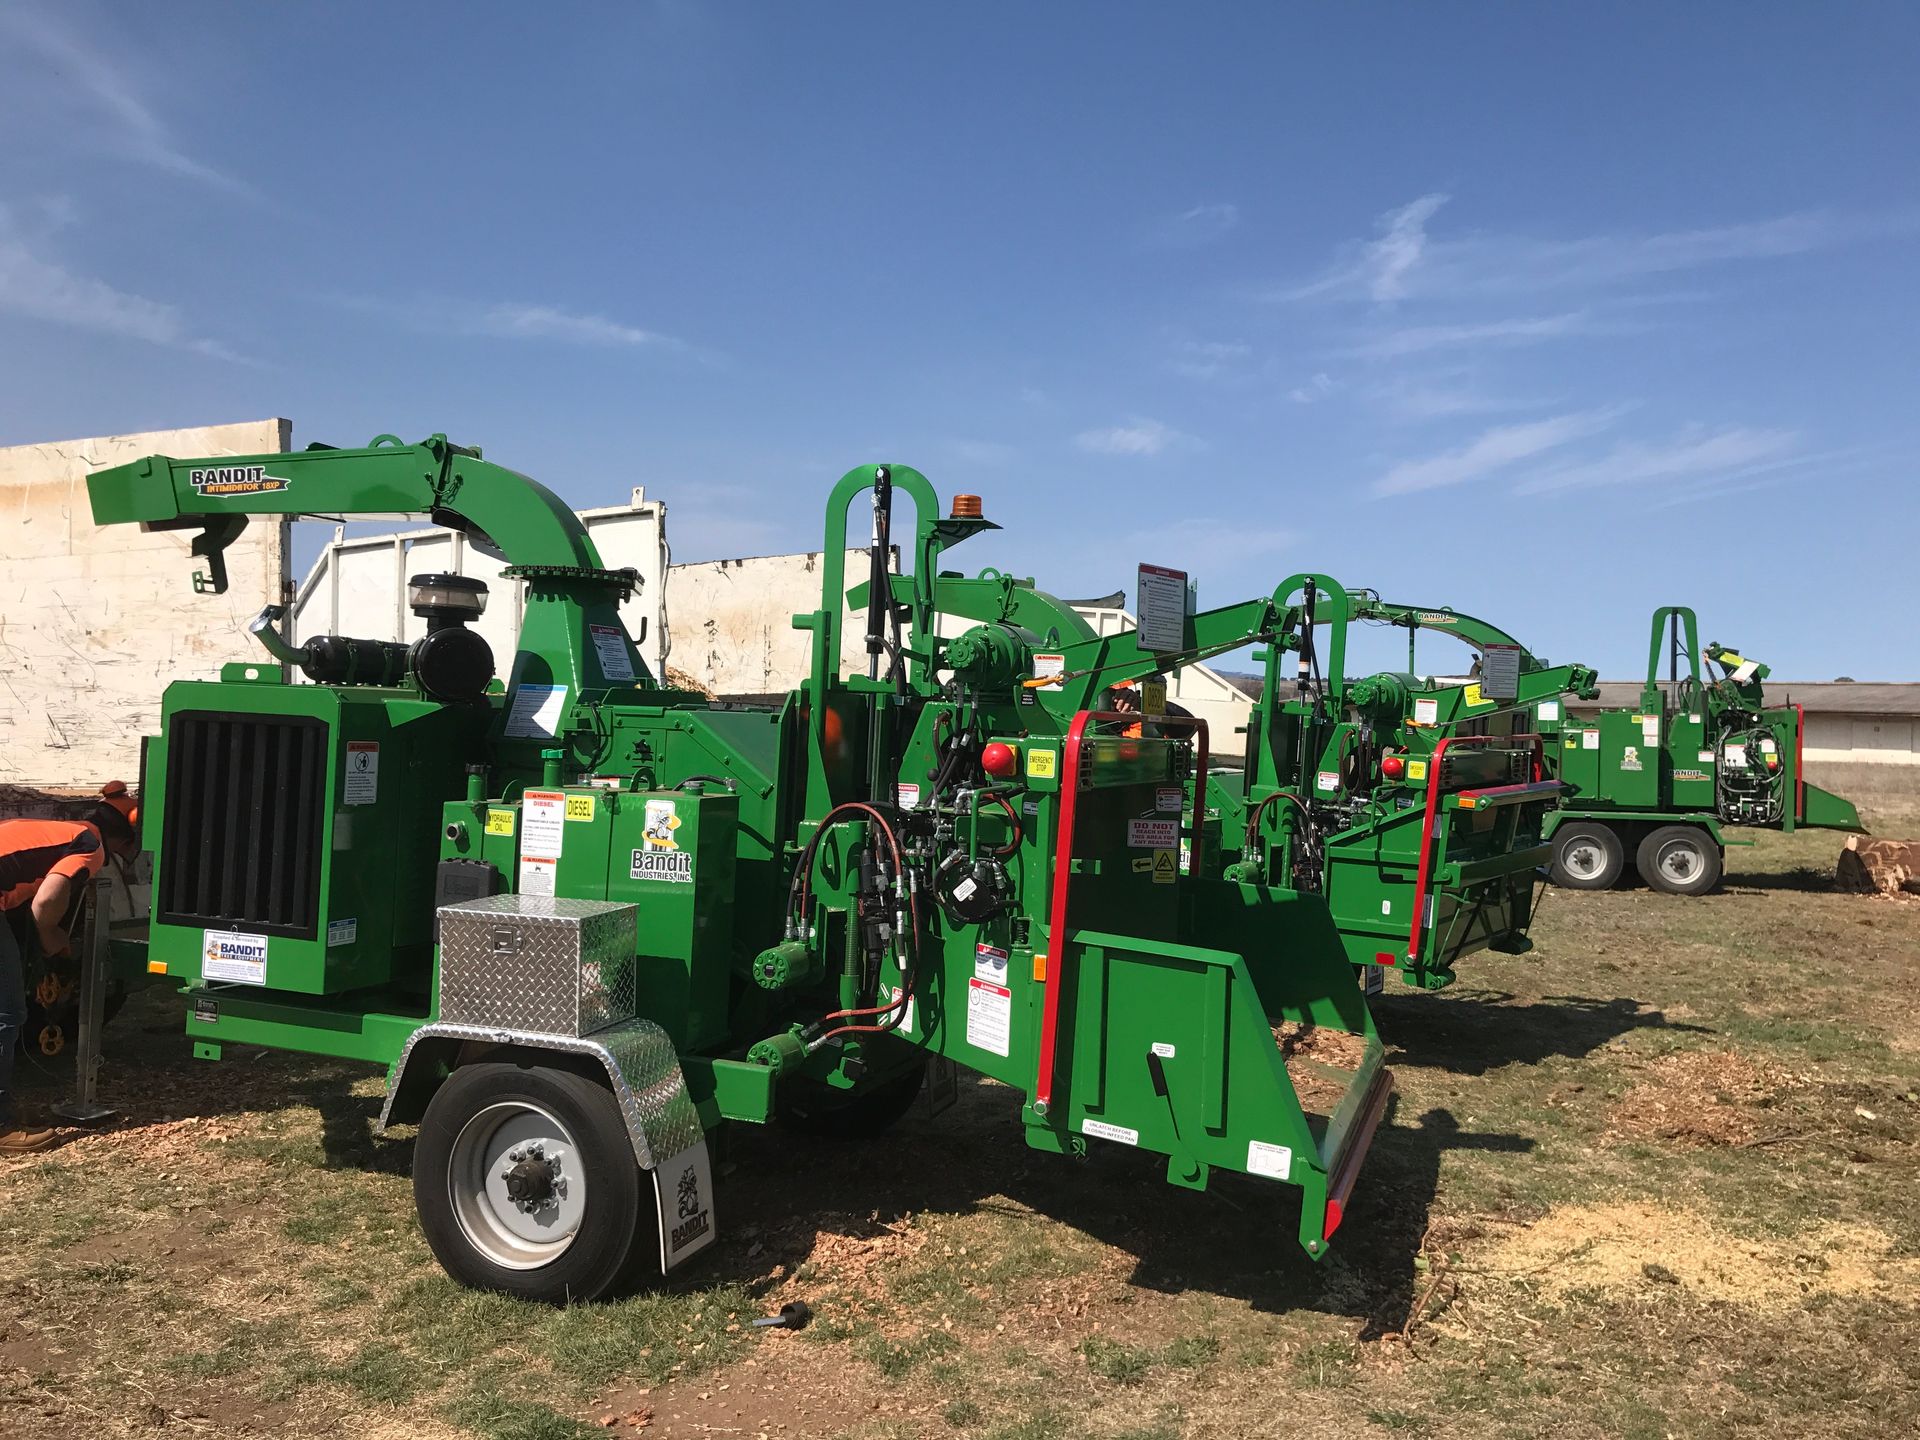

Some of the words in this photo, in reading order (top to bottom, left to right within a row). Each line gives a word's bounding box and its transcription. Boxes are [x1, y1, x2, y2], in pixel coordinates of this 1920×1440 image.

[191, 467, 265, 485] BANDIT
[207, 483, 259, 494] INTIMIDATOR
[1029, 755, 1053, 765] EMERGENCY
[1036, 764, 1047, 772] STOP
[533, 800, 555, 808] DIESEL
[568, 799, 592, 817] DIESEL
[495, 822, 504, 833] OIL
[632, 850, 691, 873] Bandit
[631, 871, 676, 882] INDUSTRIES,
[677, 873, 692, 882] INC.
[220, 943, 265, 957] BANDIT
[234, 955, 265, 963] EQUIPMENT
[1084, 1126, 1107, 1136] CLOSING
[1106, 1131, 1125, 1141] INFEED
[1089, 1122, 1112, 1132] UNLATCH
[1111, 1126, 1132, 1136] BEFORE
[671, 1209, 709, 1245] BANDIT
